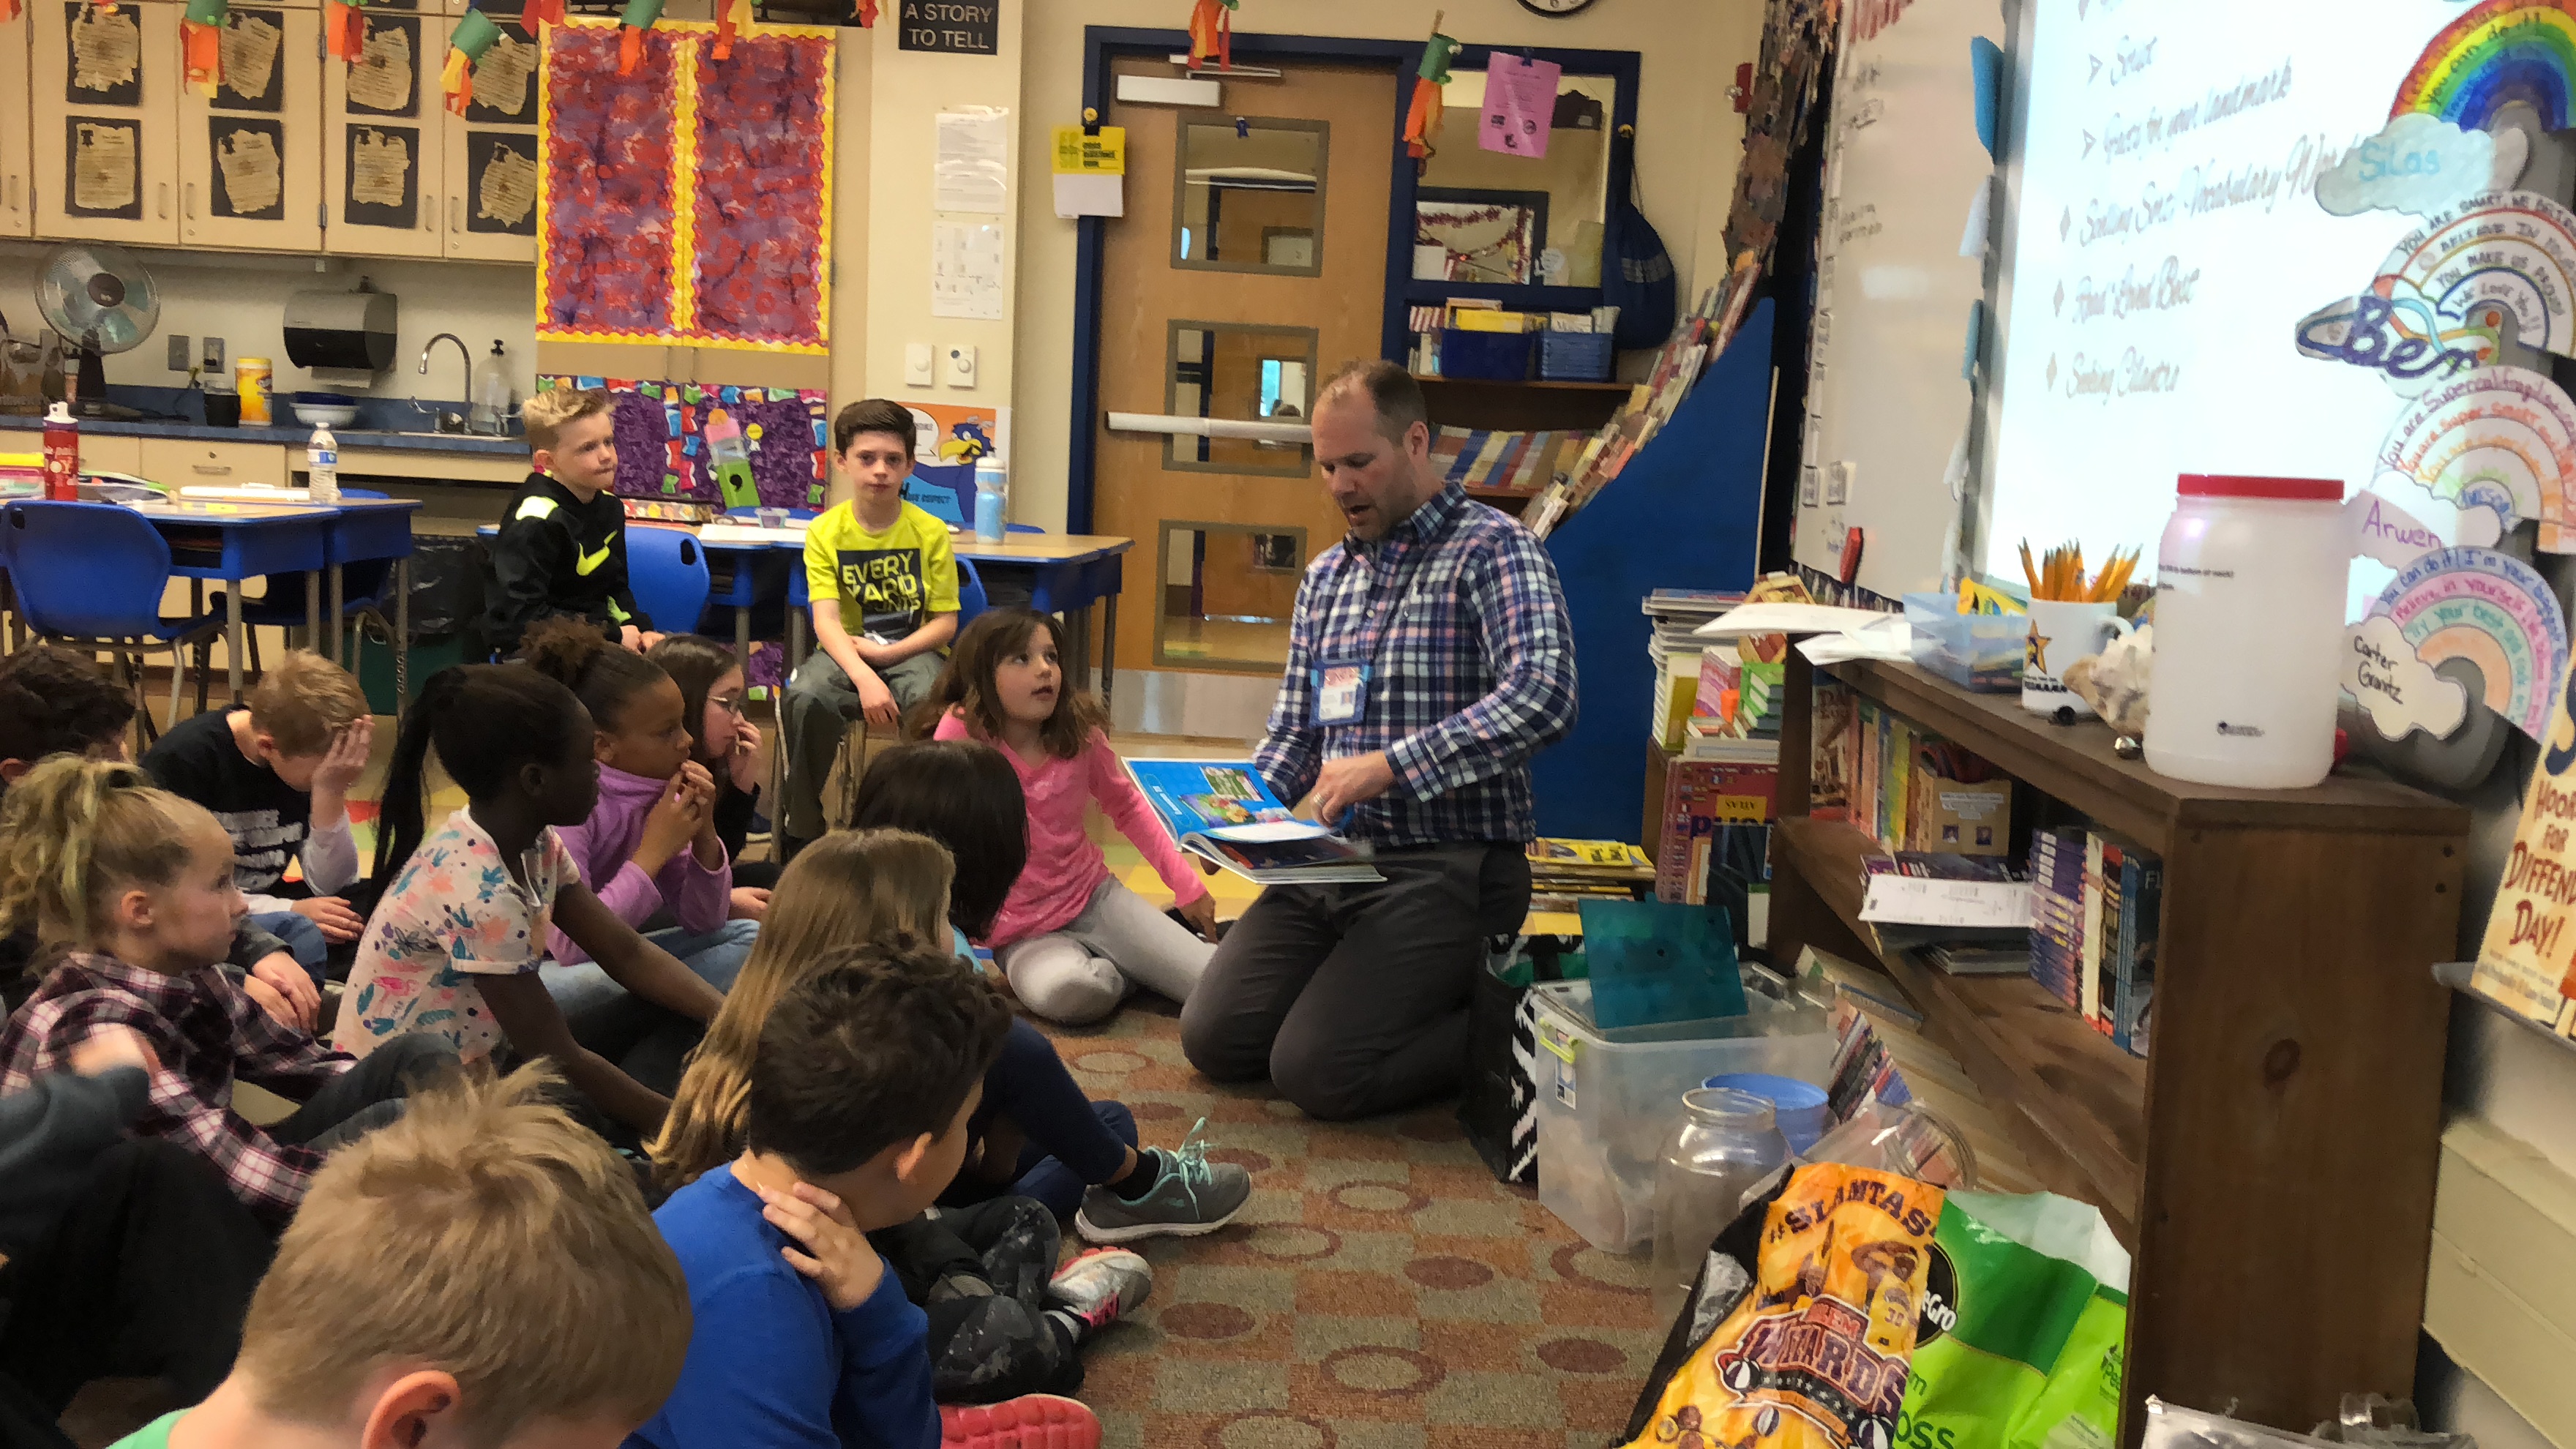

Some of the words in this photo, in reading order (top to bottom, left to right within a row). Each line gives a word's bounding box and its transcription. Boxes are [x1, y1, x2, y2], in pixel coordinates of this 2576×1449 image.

[905, 3, 919, 20] A
[924, 3, 993, 23] STORY
[907, 27, 937, 46] TO
[941, 30, 989, 49] TELL
[2341, 296, 2480, 381] Ben
[2362, 498, 2442, 550] Arwen
[842, 551, 914, 585] EVERY
[845, 573, 918, 604] YARD
[2354, 634, 2399, 673] Carter
